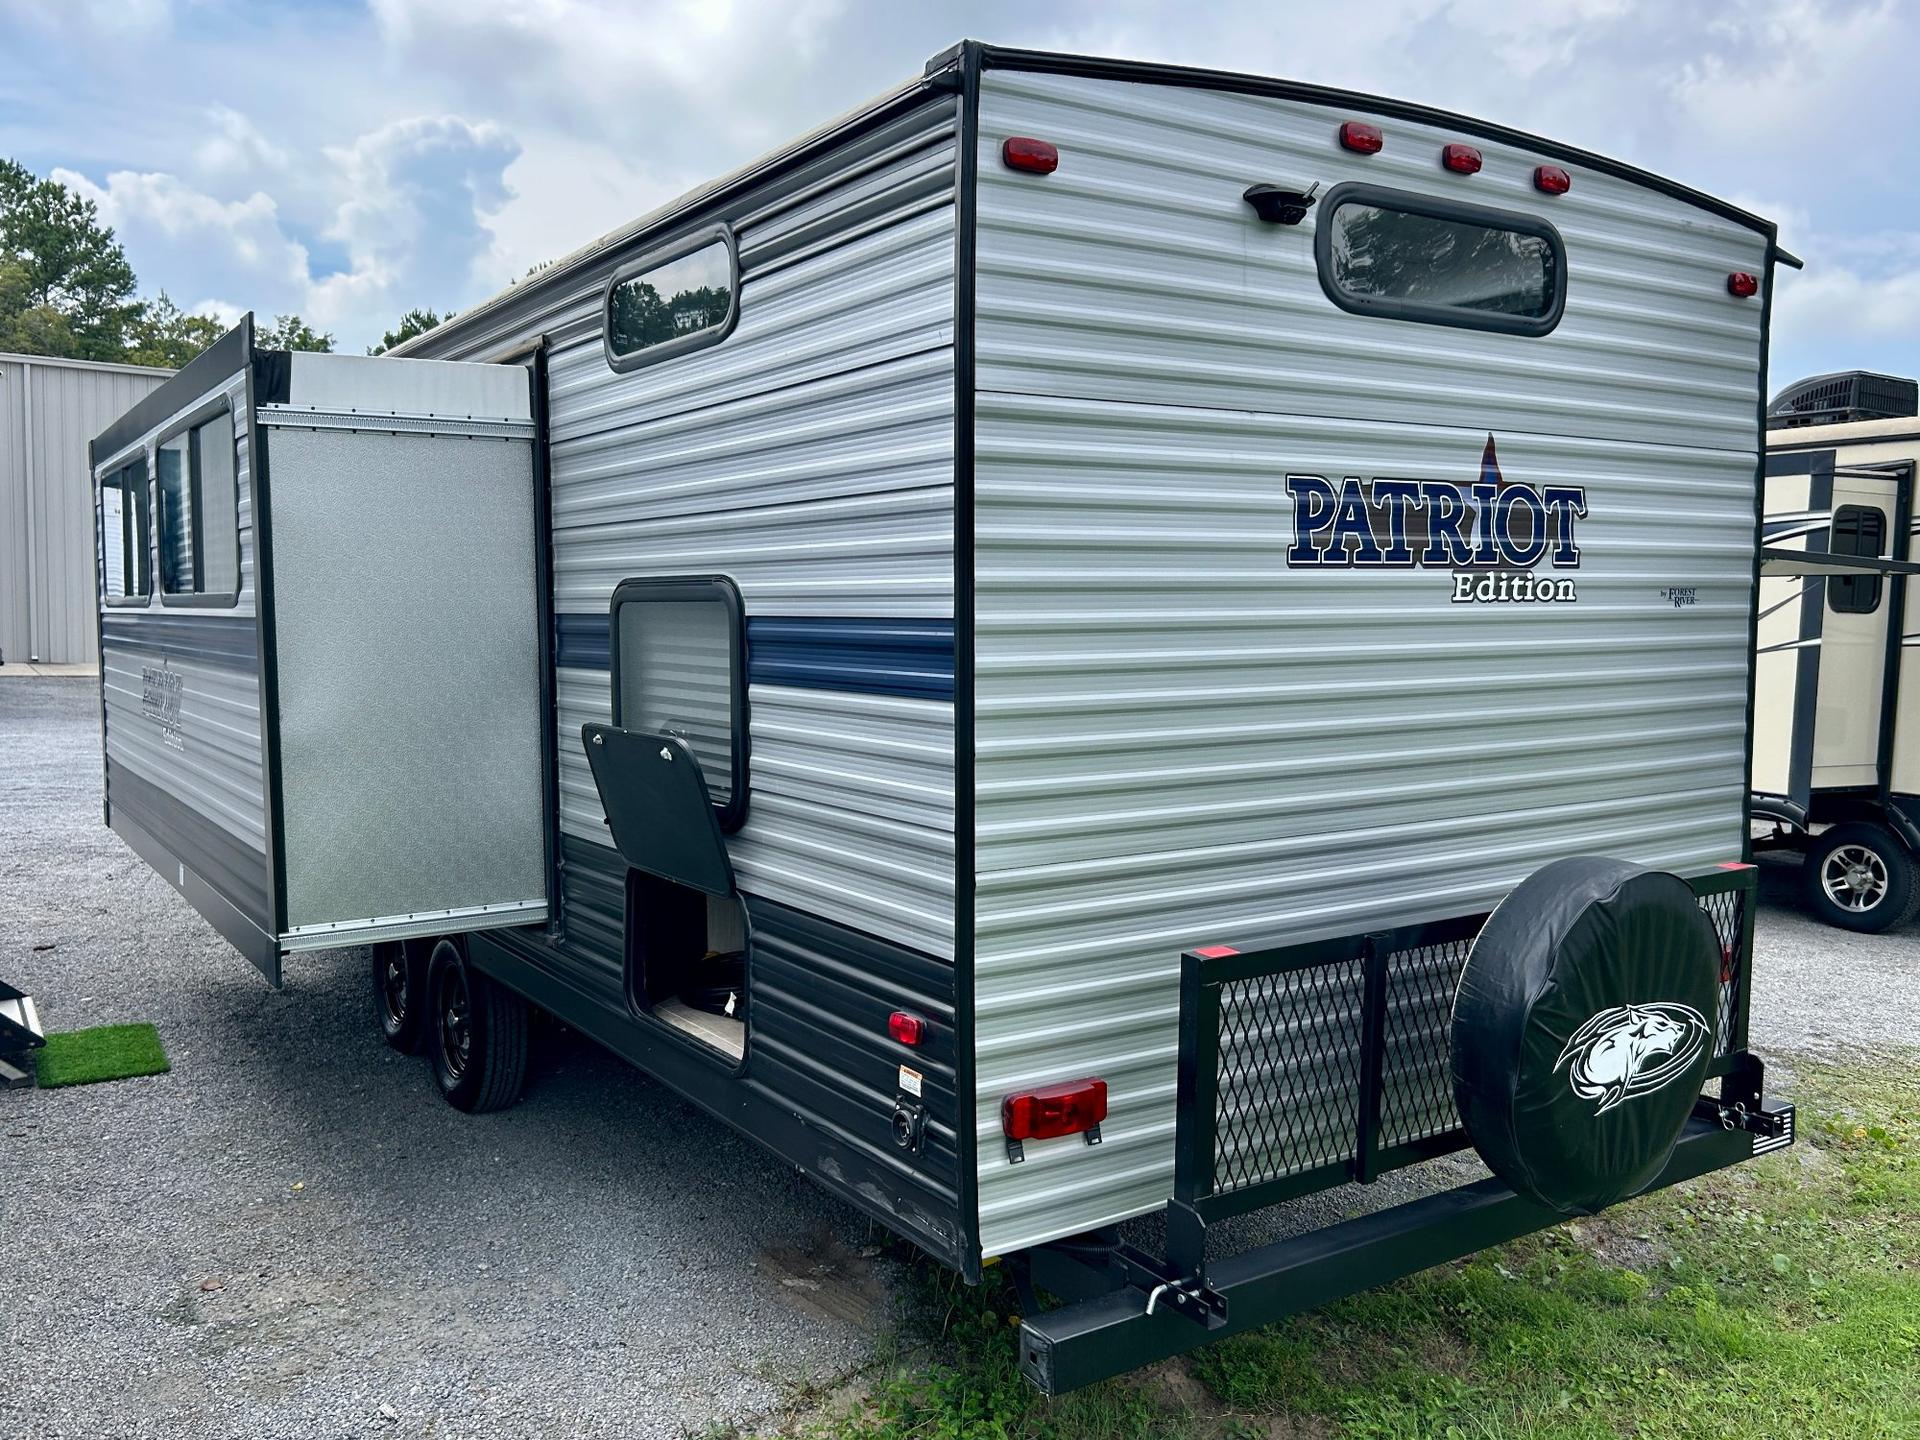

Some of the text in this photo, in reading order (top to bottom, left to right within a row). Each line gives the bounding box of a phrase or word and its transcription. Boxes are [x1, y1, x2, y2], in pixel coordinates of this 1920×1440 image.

[1286, 474, 1588, 568] PATRIOT
[1452, 571, 1576, 602] Edition
[1669, 588, 1696, 599] FOREST
[1674, 596, 1696, 608] RIVER
